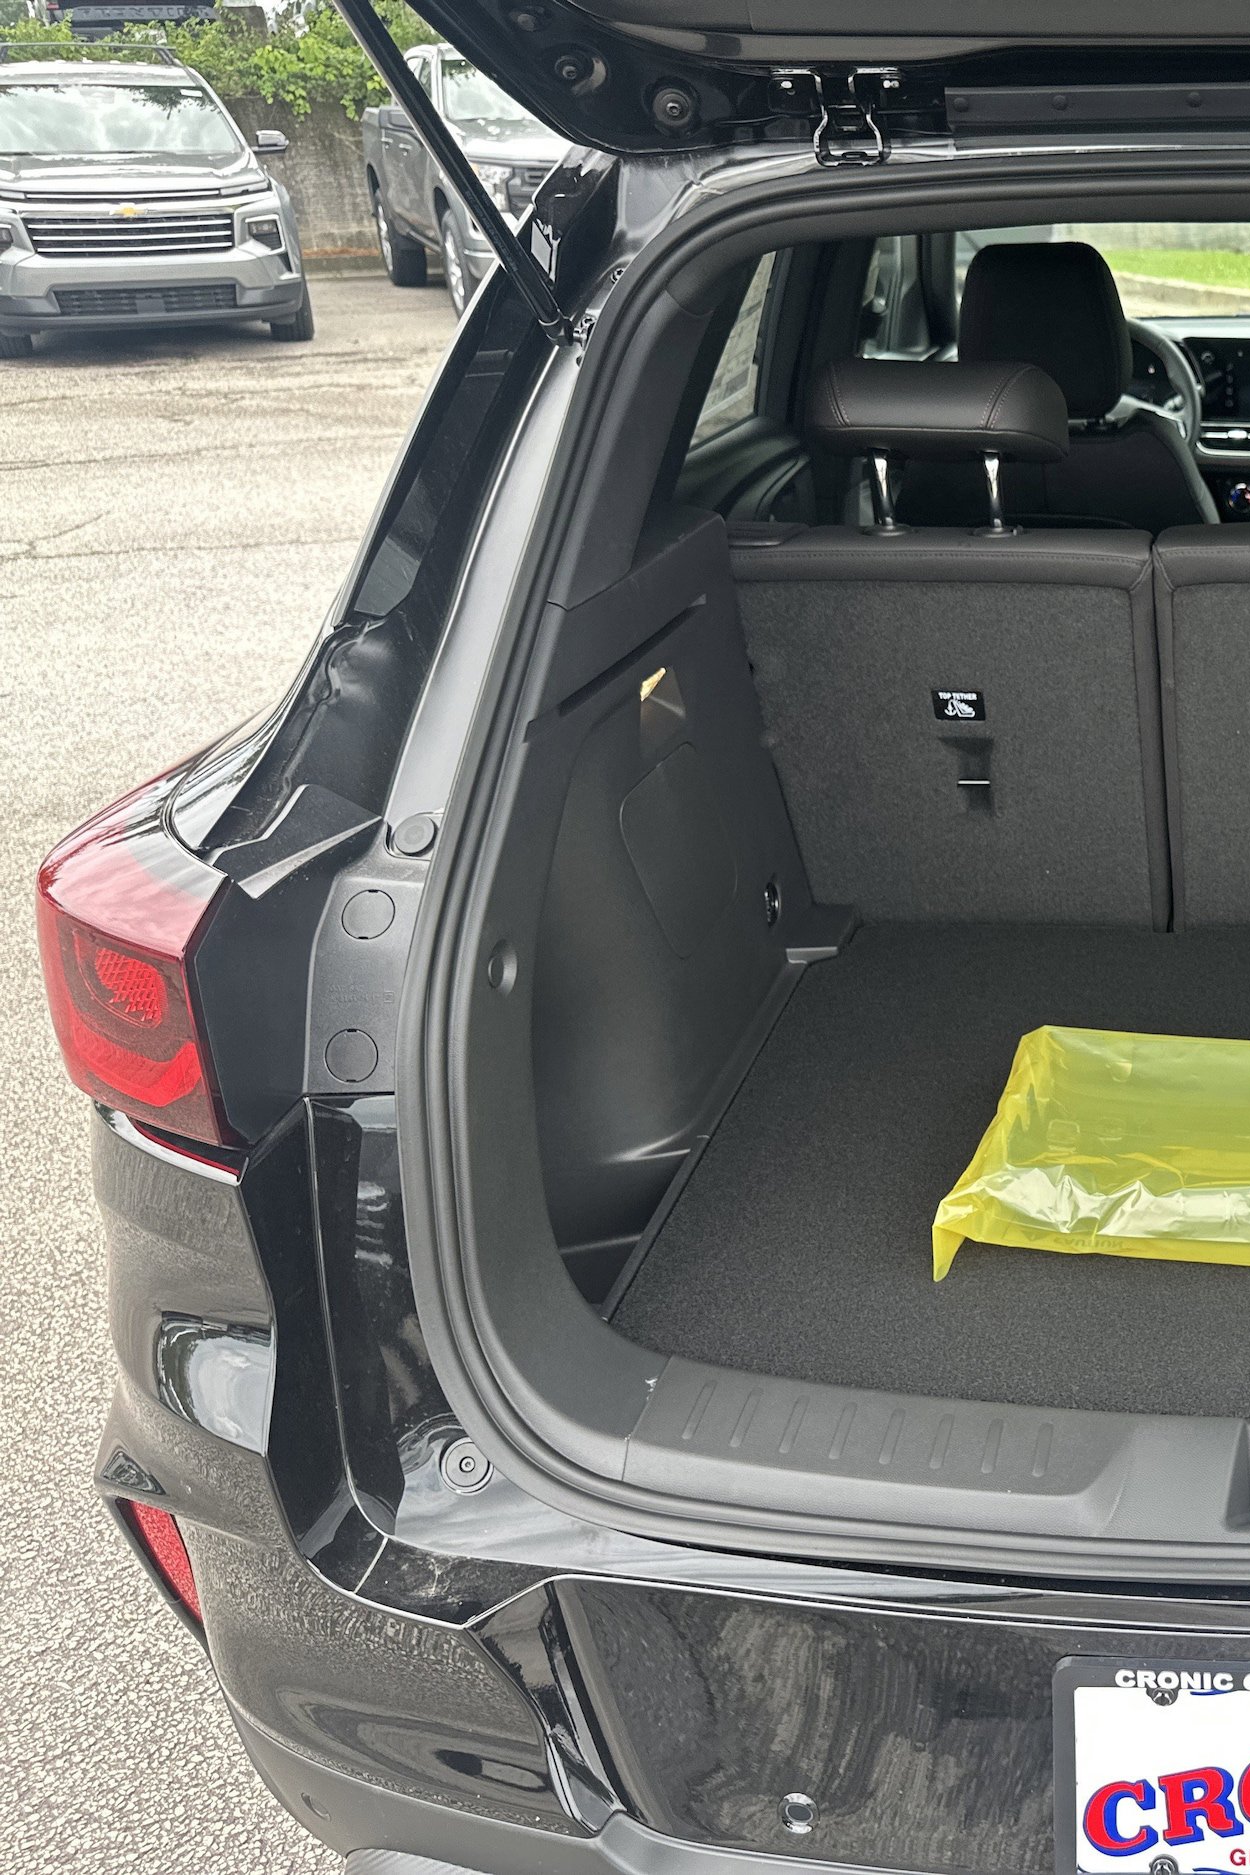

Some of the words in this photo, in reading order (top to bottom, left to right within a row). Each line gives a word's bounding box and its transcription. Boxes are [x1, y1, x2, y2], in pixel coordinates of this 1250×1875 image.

[938, 691, 952, 700] TOP
[952, 692, 978, 701] TETHER
[1114, 1669, 1234, 1691] CRONIC
